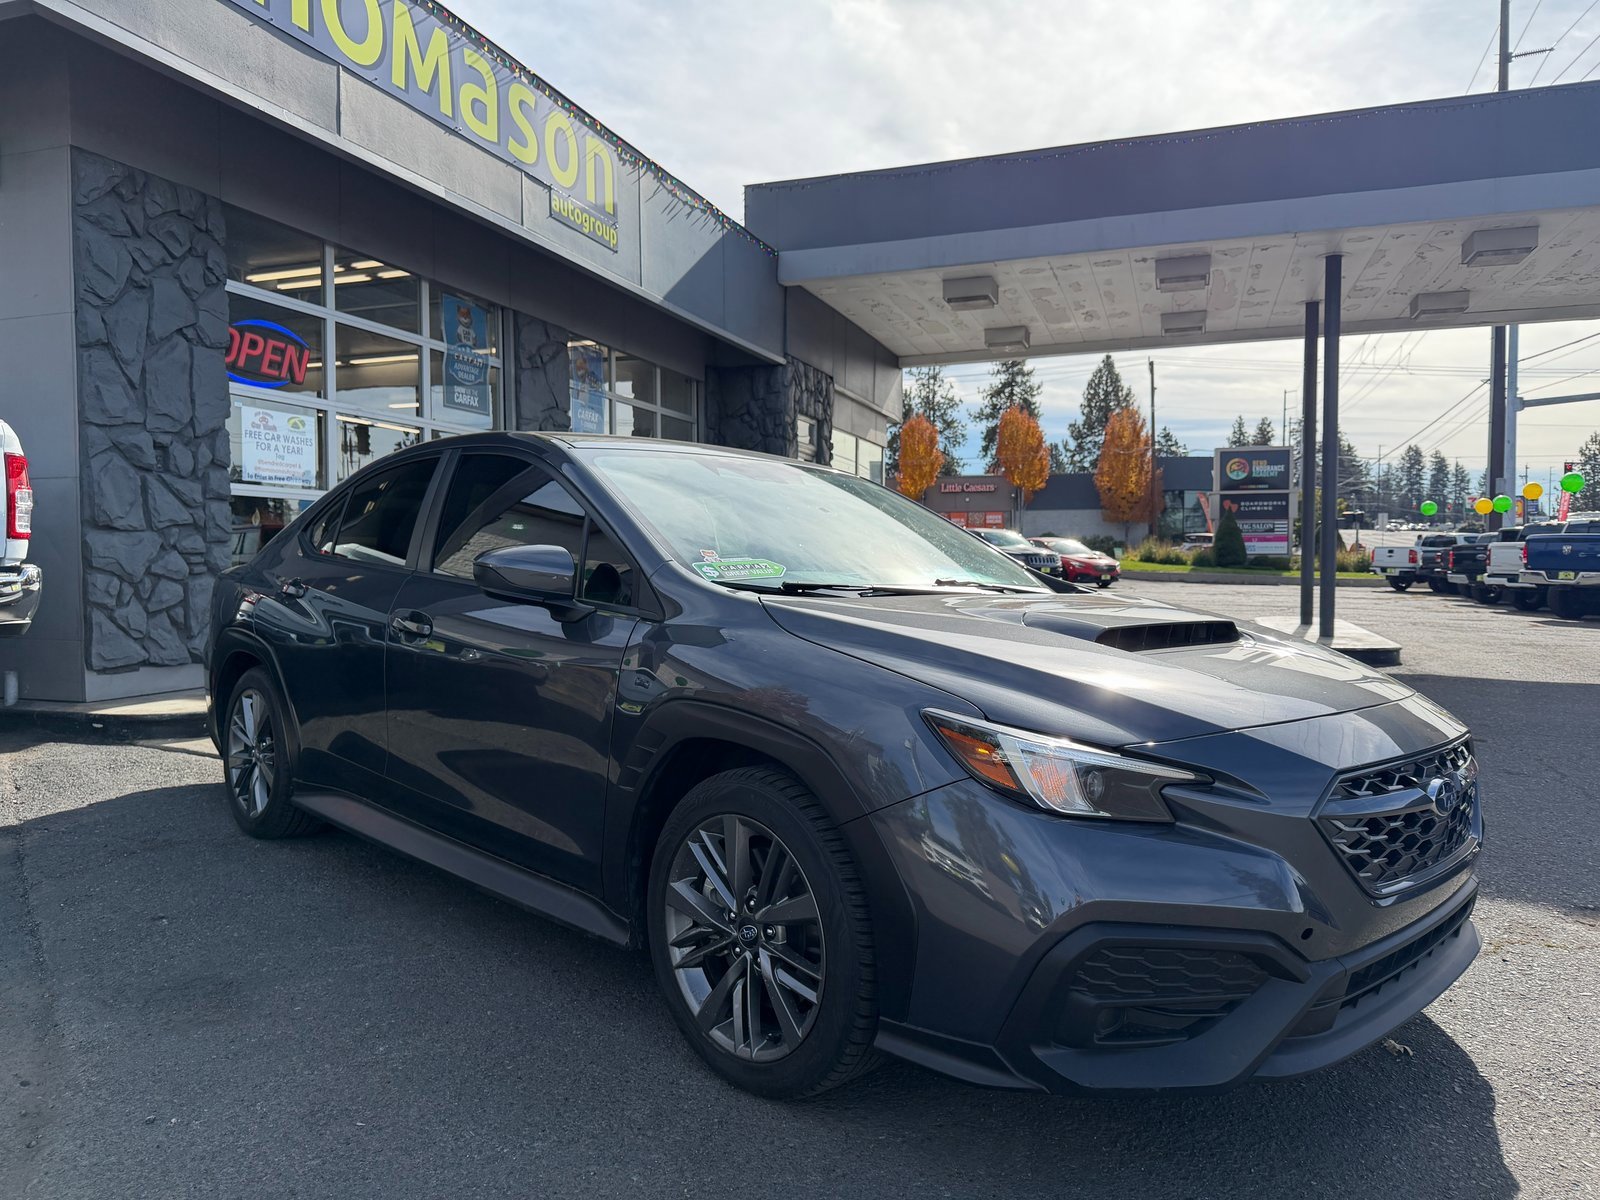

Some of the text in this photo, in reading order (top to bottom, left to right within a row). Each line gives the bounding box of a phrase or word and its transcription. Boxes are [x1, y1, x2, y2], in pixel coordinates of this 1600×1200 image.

[553, 194, 617, 248] autogroup
[457, 371, 475, 381] DEALER
[454, 392, 479, 407] CARFAX
[244, 429, 262, 440] FREE
[264, 432, 281, 443] CAR
[283, 434, 313, 447] WASHES
[256, 441, 304, 455] FOR A YEAR!
[941, 482, 995, 493] Little Caesars
[1251, 522, 1274, 530] SALON
[719, 563, 771, 571] CARFAX
[725, 569, 750, 577] GREAT
